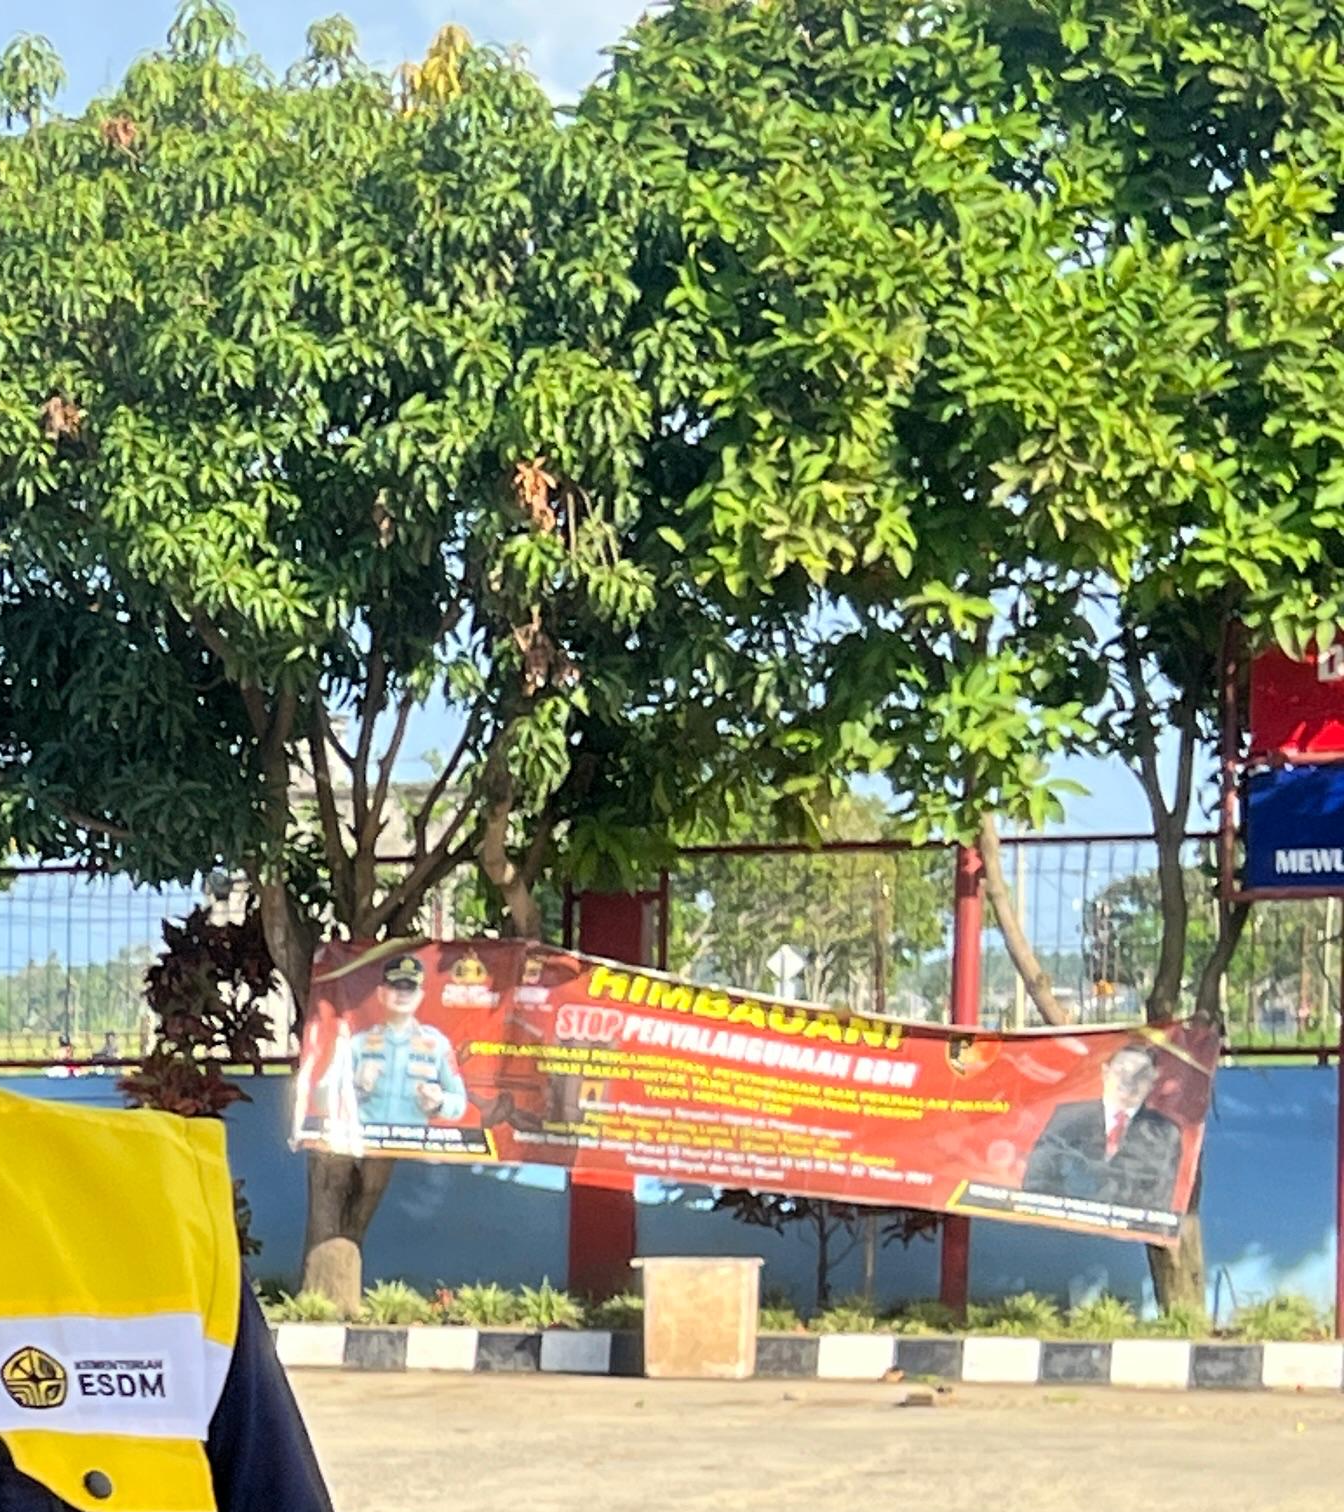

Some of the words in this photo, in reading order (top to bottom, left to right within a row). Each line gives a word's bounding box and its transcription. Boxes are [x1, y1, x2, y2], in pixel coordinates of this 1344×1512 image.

[556, 1004, 623, 1041] STOP
[852, 1056, 920, 1088] BBM
[78, 1373, 166, 1398] ESDM
